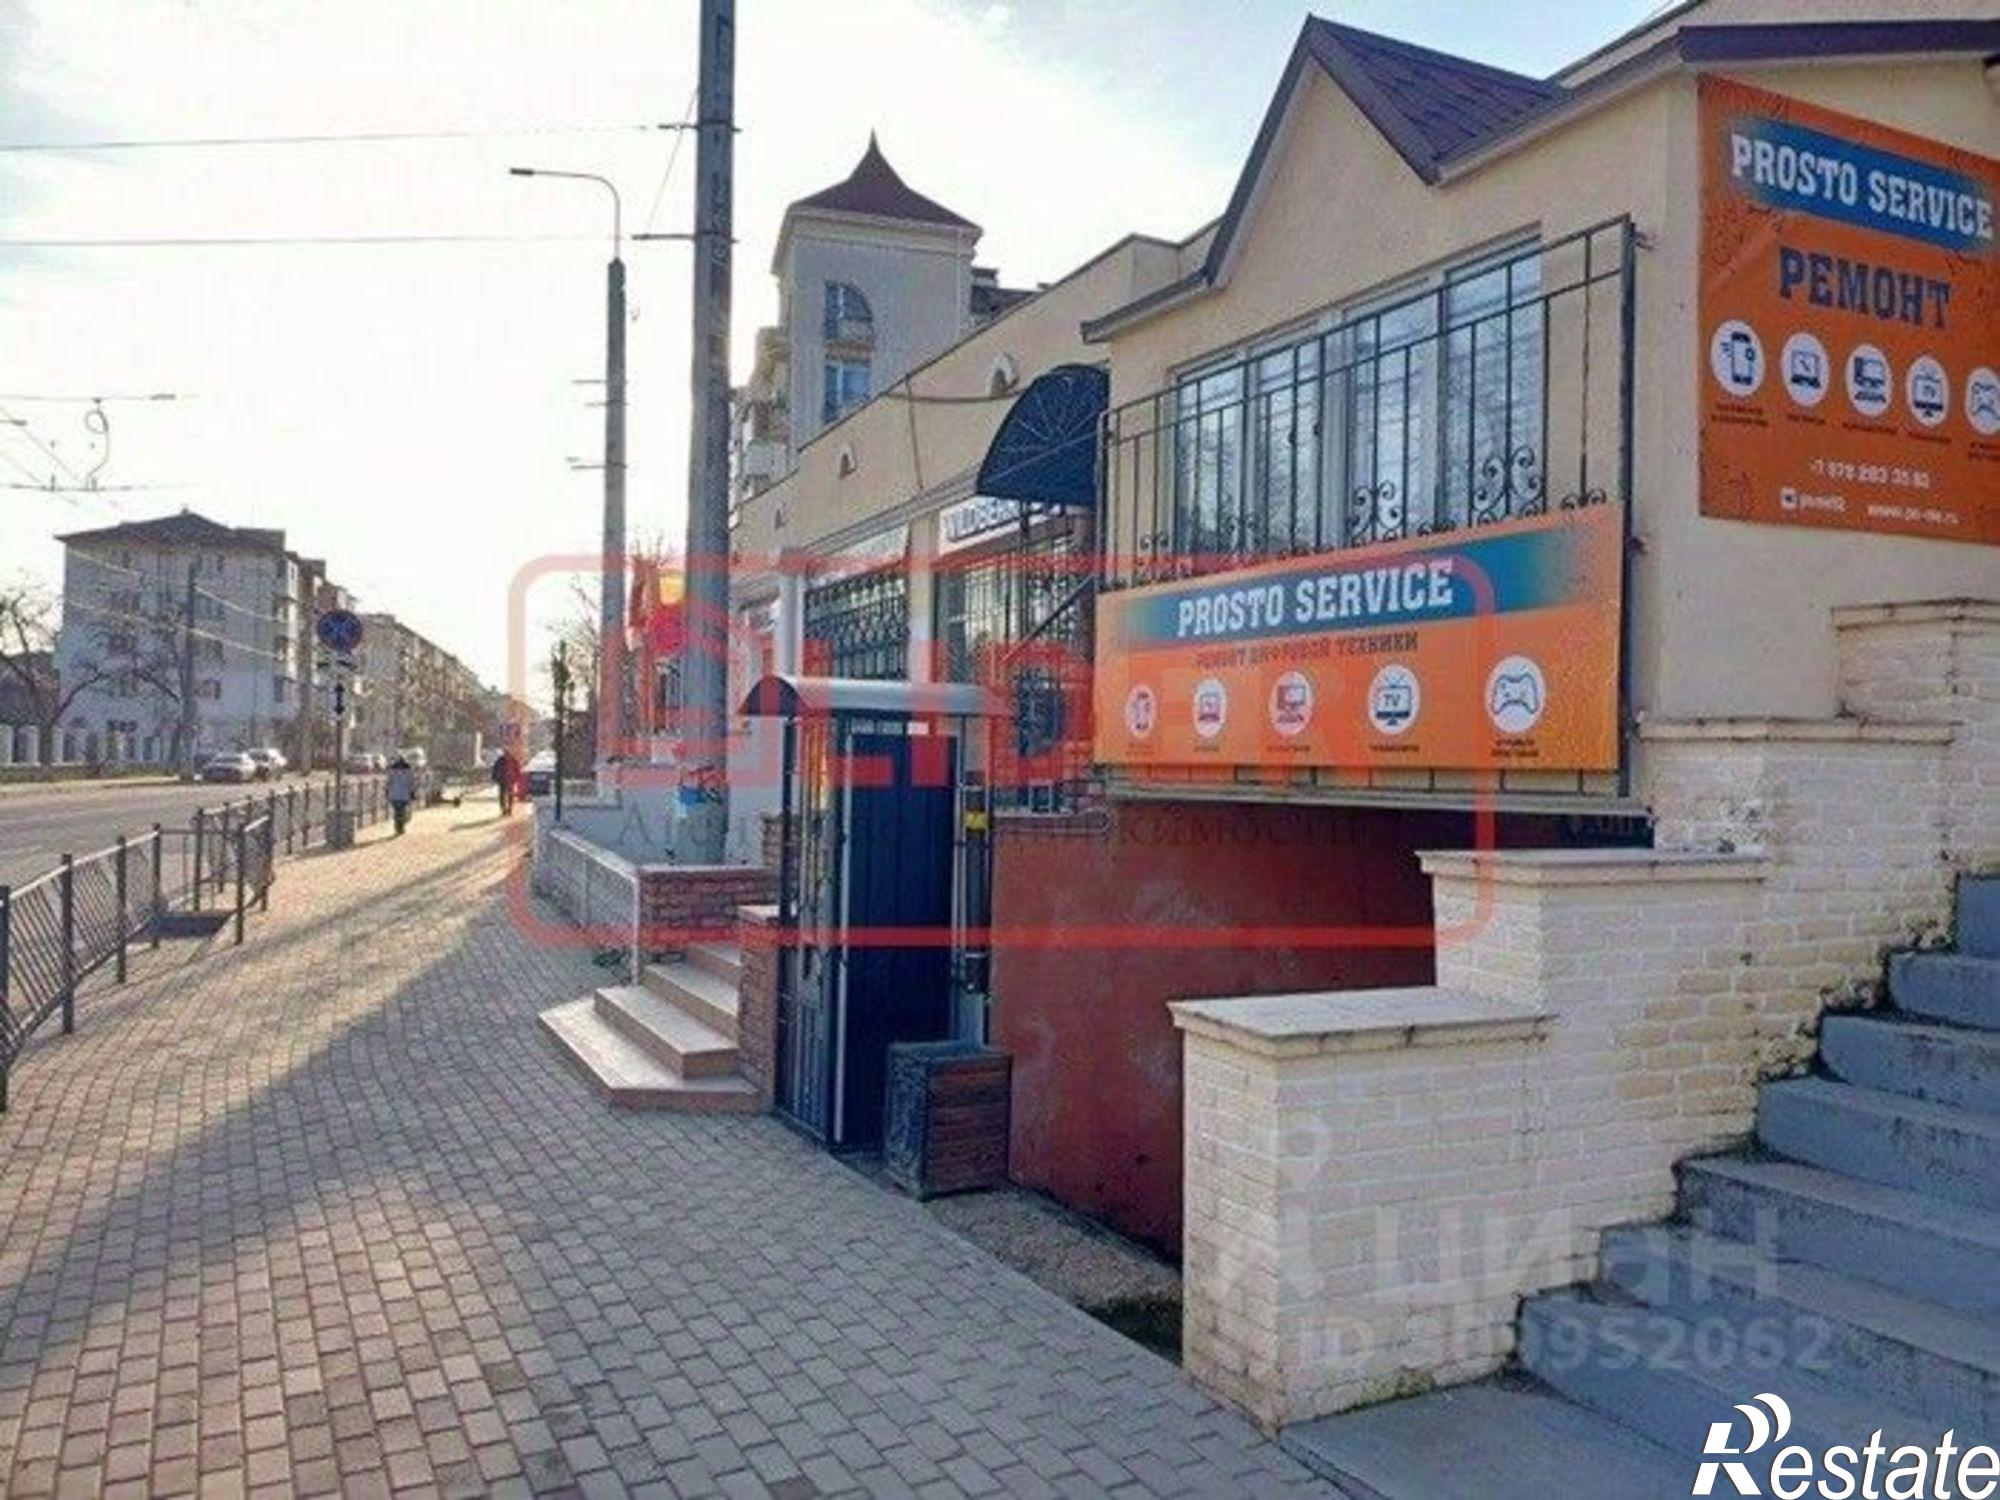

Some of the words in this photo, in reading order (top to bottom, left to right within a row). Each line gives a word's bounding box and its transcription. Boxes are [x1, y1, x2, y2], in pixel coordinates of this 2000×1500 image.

[1731, 134, 1858, 207] PROSTO
[1868, 169, 1995, 239] SERVICE
[1778, 244, 1951, 330] РЕМОНТ
[1176, 588, 1285, 638] PROSTO
[1296, 558, 1454, 622] SERVICE
